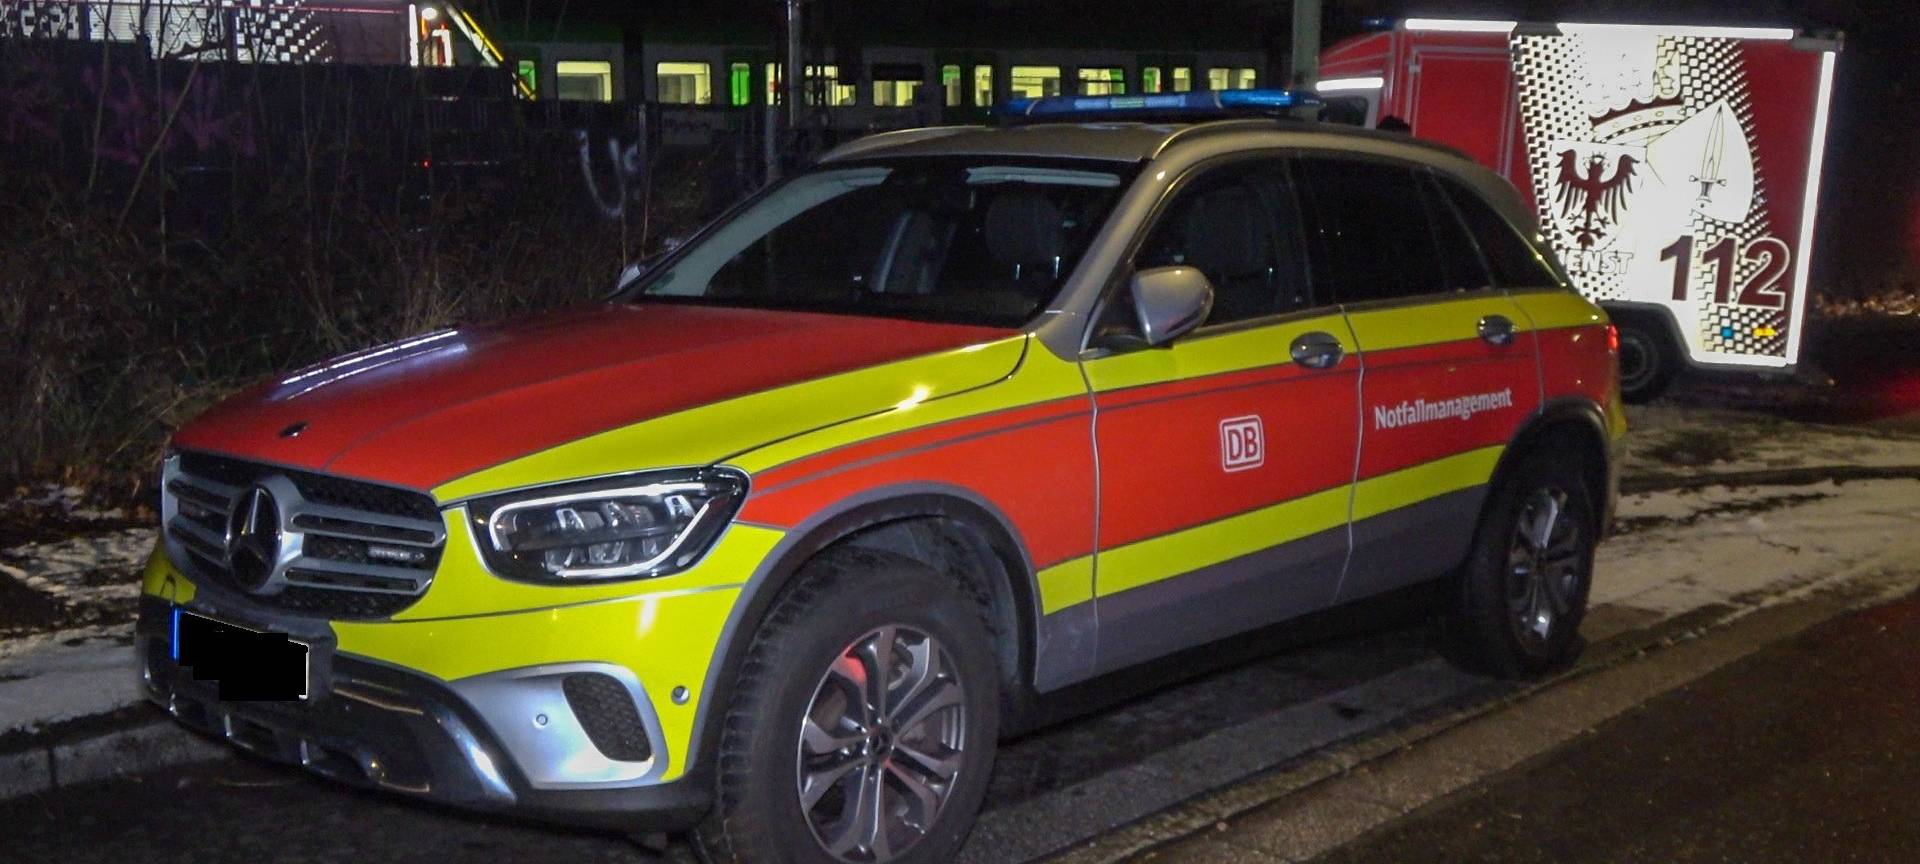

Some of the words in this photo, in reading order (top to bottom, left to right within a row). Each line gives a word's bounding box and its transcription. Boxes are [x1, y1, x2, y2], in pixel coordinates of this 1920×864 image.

[1555, 249, 1634, 275] IENST
[1659, 234, 1787, 310] 112
[1374, 387, 1513, 430] Notfallmanagement
[1227, 425, 1258, 462] DB
